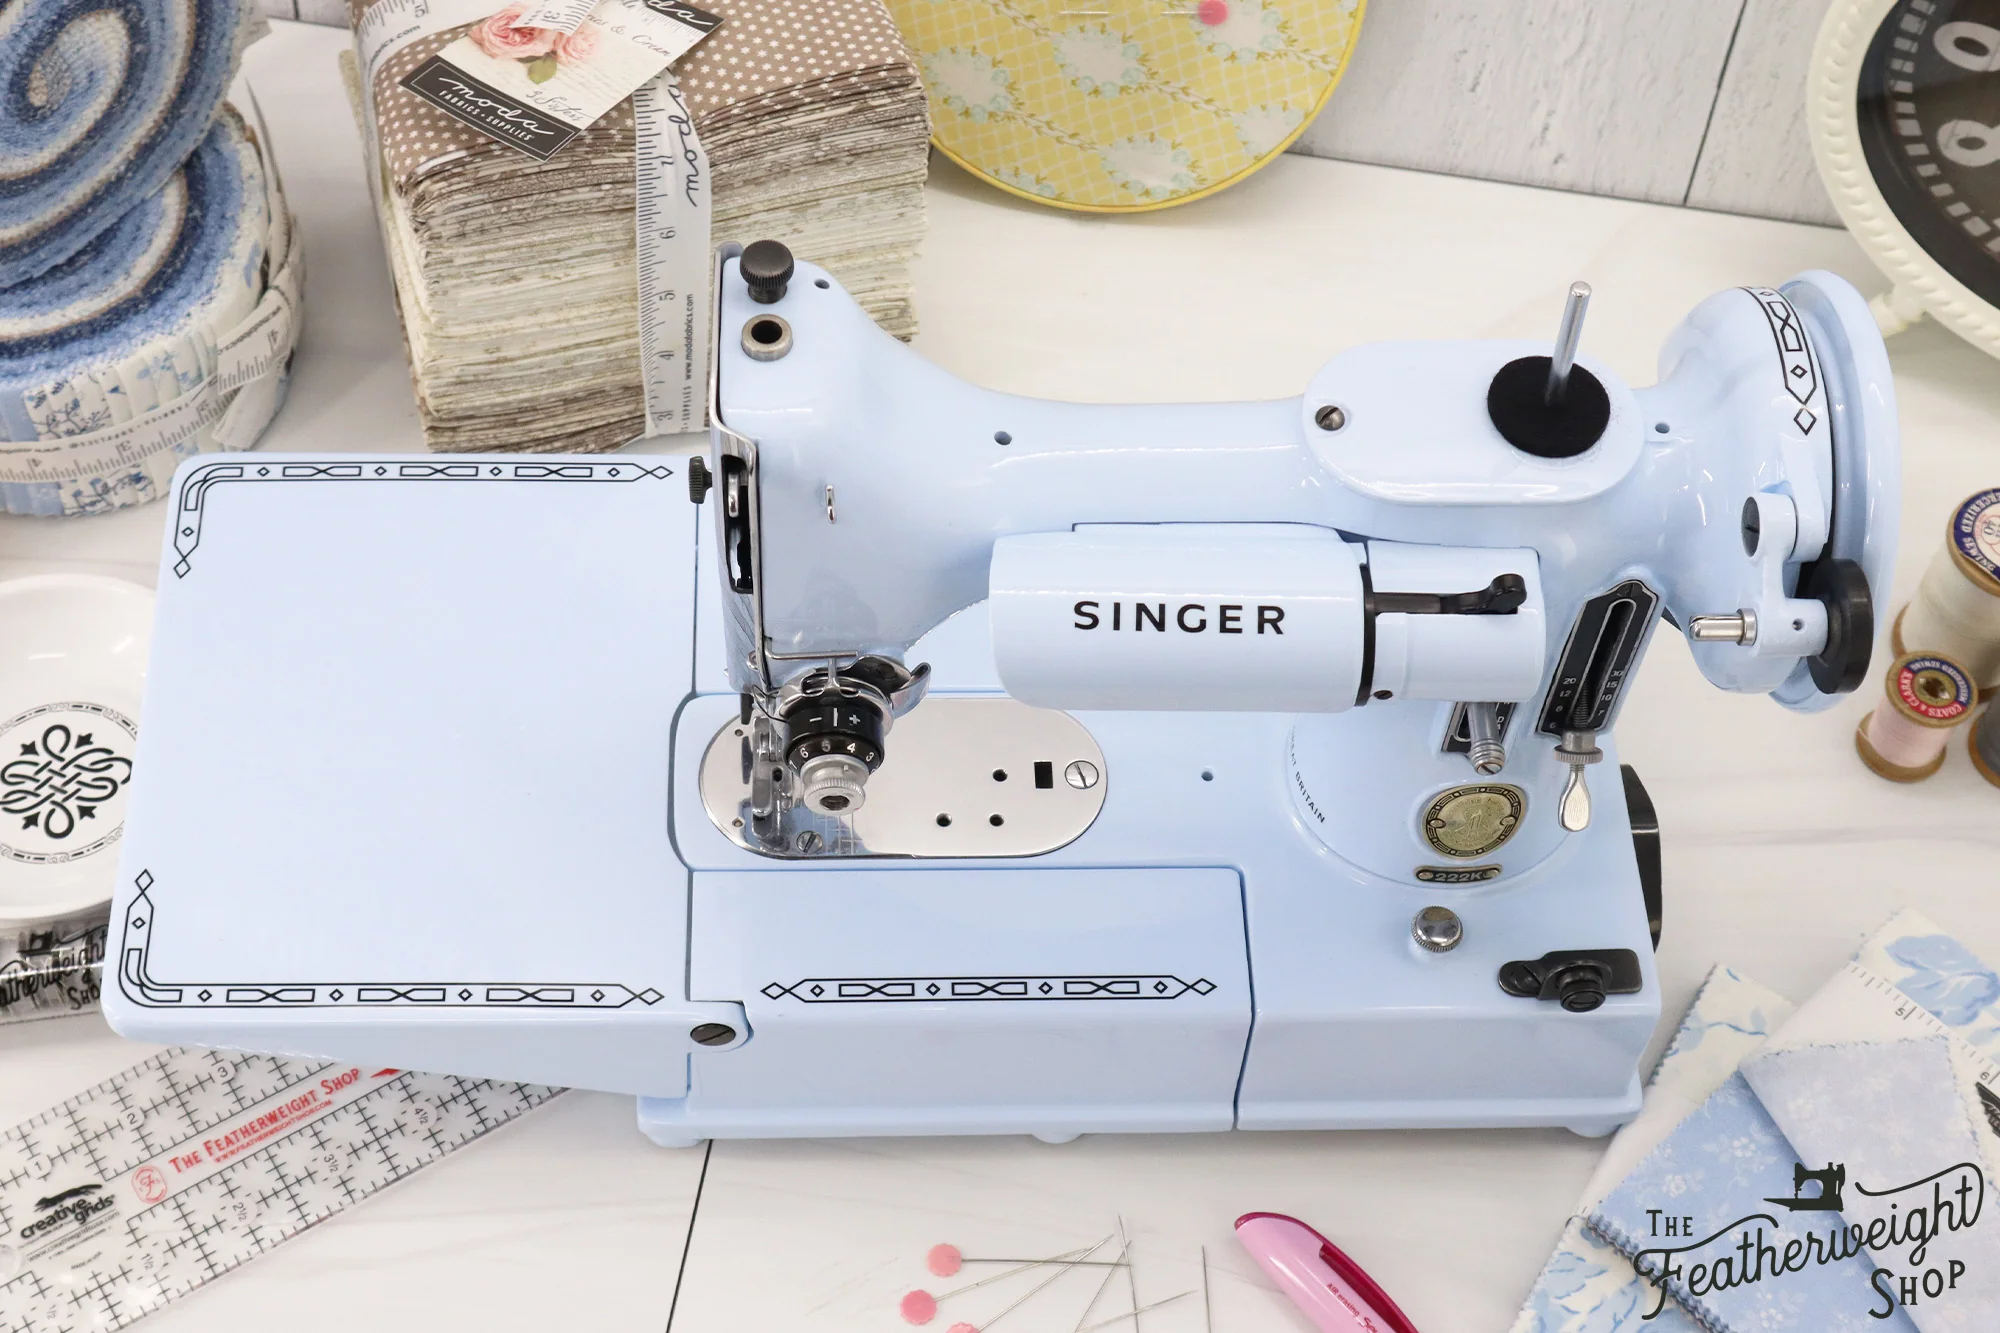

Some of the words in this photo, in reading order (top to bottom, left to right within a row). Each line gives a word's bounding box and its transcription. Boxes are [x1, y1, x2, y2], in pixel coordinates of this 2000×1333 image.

[439, 77, 554, 135] moda
[439, 90, 477, 117] FABRICS
[486, 115, 534, 142] SUPPLIES
[1074, 601, 1285, 635] SINGER
[1563, 677, 1577, 685] 20
[1606, 681, 1618, 689] 15
[1928, 702, 1963, 718] COATS
[800, 747, 809, 759] 6
[821, 740, 831, 752] 5
[847, 742, 856, 753] 4
[865, 751, 875, 762] 3
[1295, 771, 1326, 823] BRITAIN
[1434, 872, 1483, 882] 222K
[1894, 1007, 1905, 1017] 5
[217, 1066, 229, 1079] 3
[1980, 1071, 1990, 1081] 6
[126, 1112, 139, 1125] 2
[168, 1151, 203, 1174] THE
[203, 1090, 319, 1156] FEATHERWEIGHT
[320, 1068, 360, 1096] SHOP
[20, 1198, 87, 1239] creative
